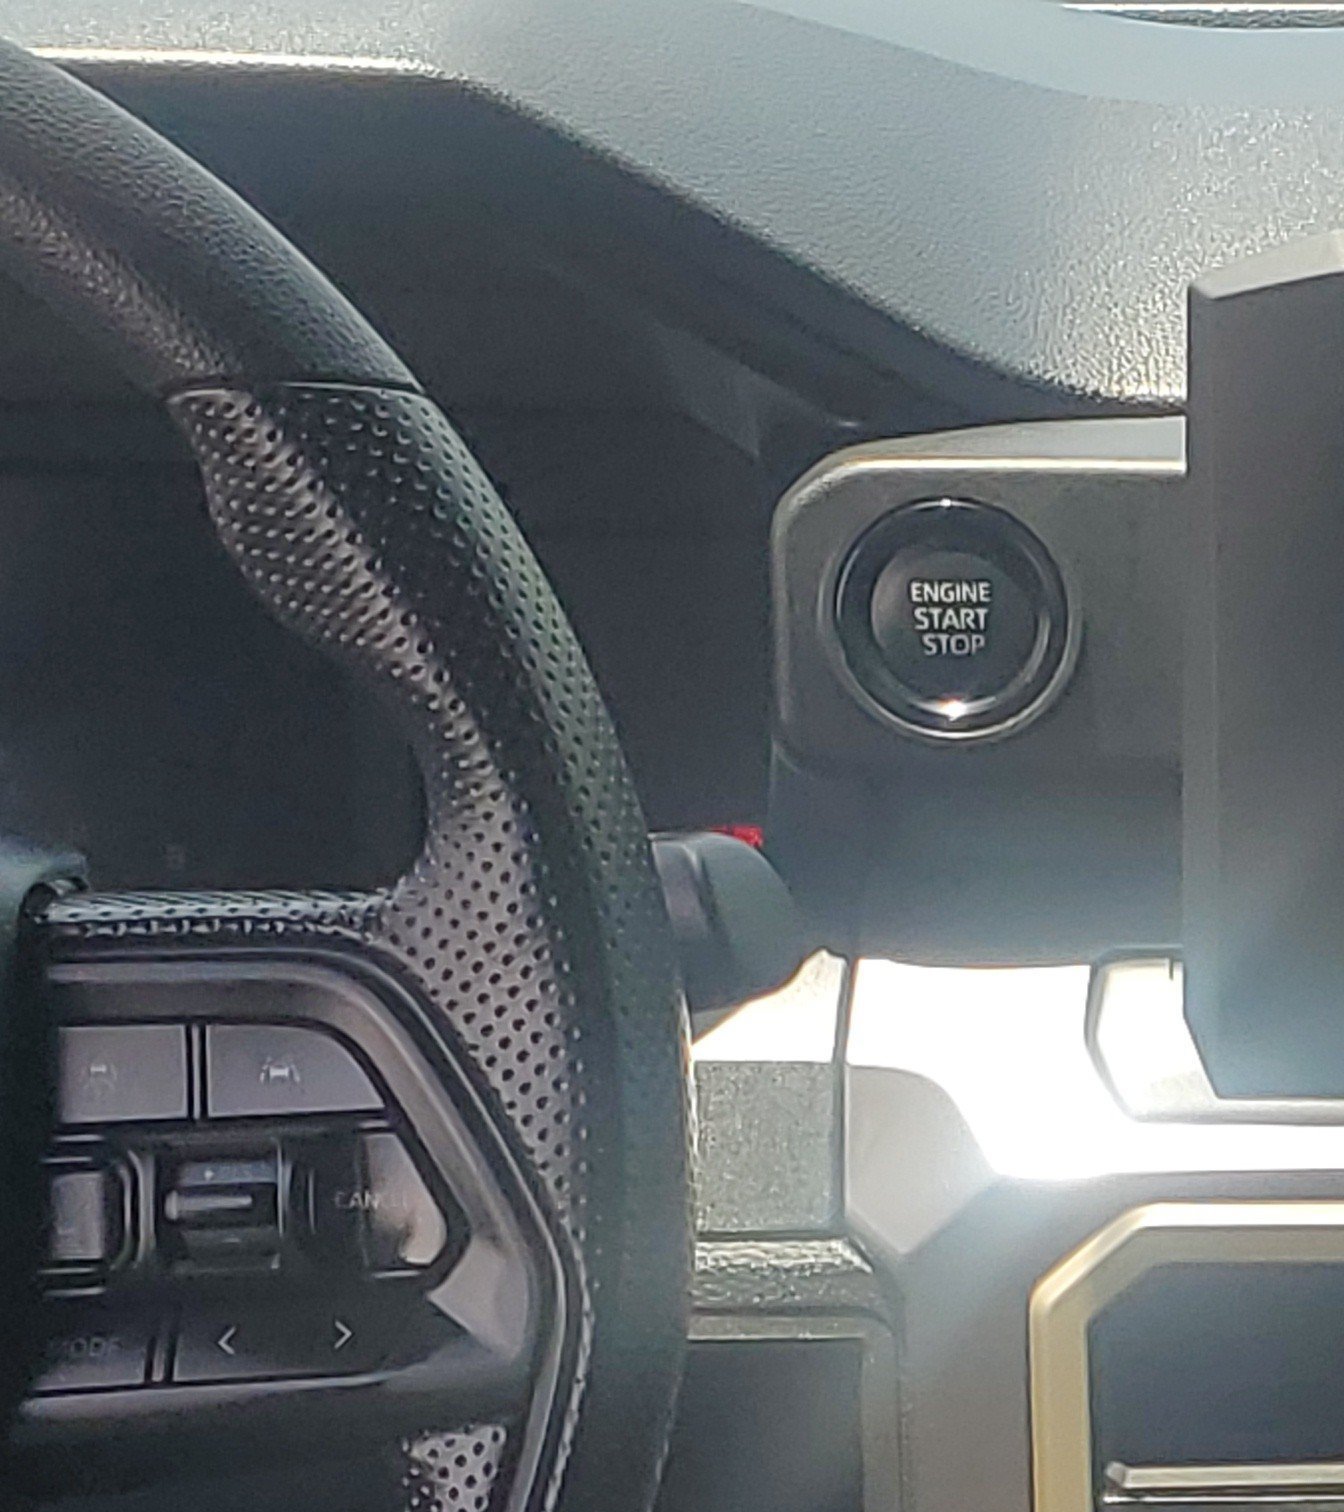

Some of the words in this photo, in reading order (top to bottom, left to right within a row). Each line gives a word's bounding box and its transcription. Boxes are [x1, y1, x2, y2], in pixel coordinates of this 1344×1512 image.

[910, 581, 991, 603] ENGINE
[914, 607, 989, 630] START
[922, 633, 986, 656] STOP
